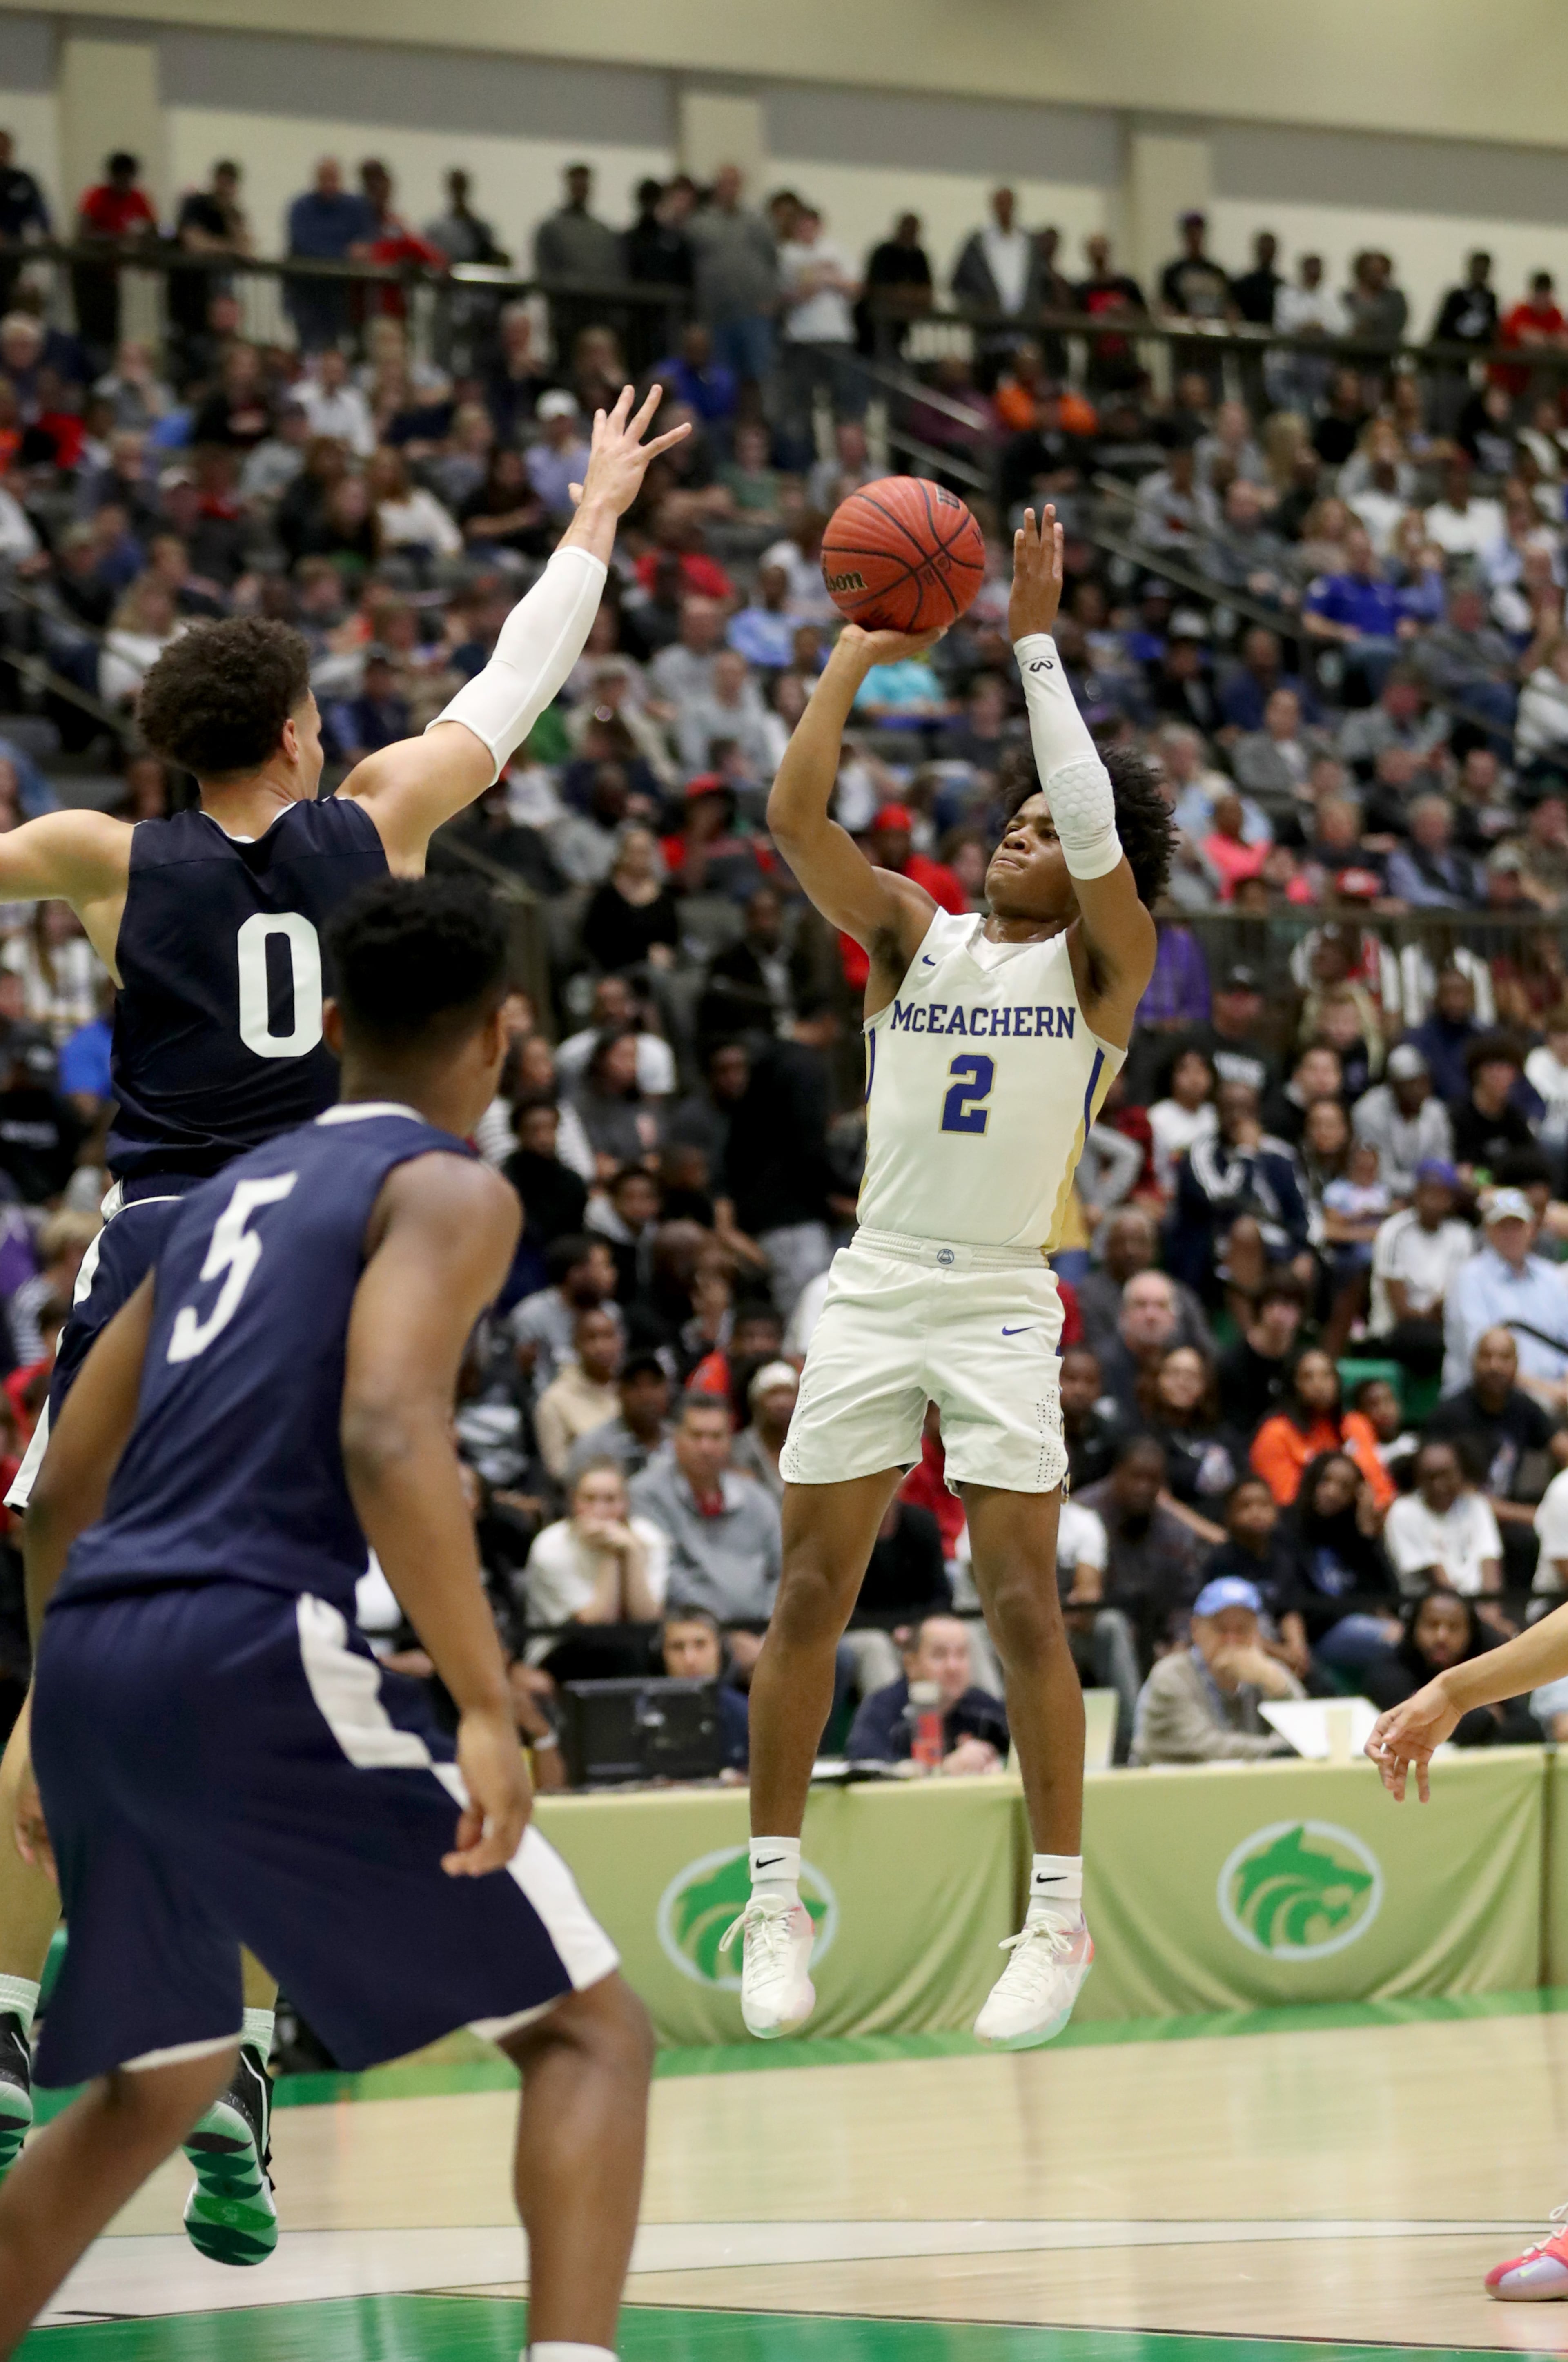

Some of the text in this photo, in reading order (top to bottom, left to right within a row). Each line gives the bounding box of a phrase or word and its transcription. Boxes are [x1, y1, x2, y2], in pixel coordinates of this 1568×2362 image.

[237, 912, 323, 1058] 0
[939, 1052, 996, 1136] 2
[167, 1170, 299, 1363] 5
